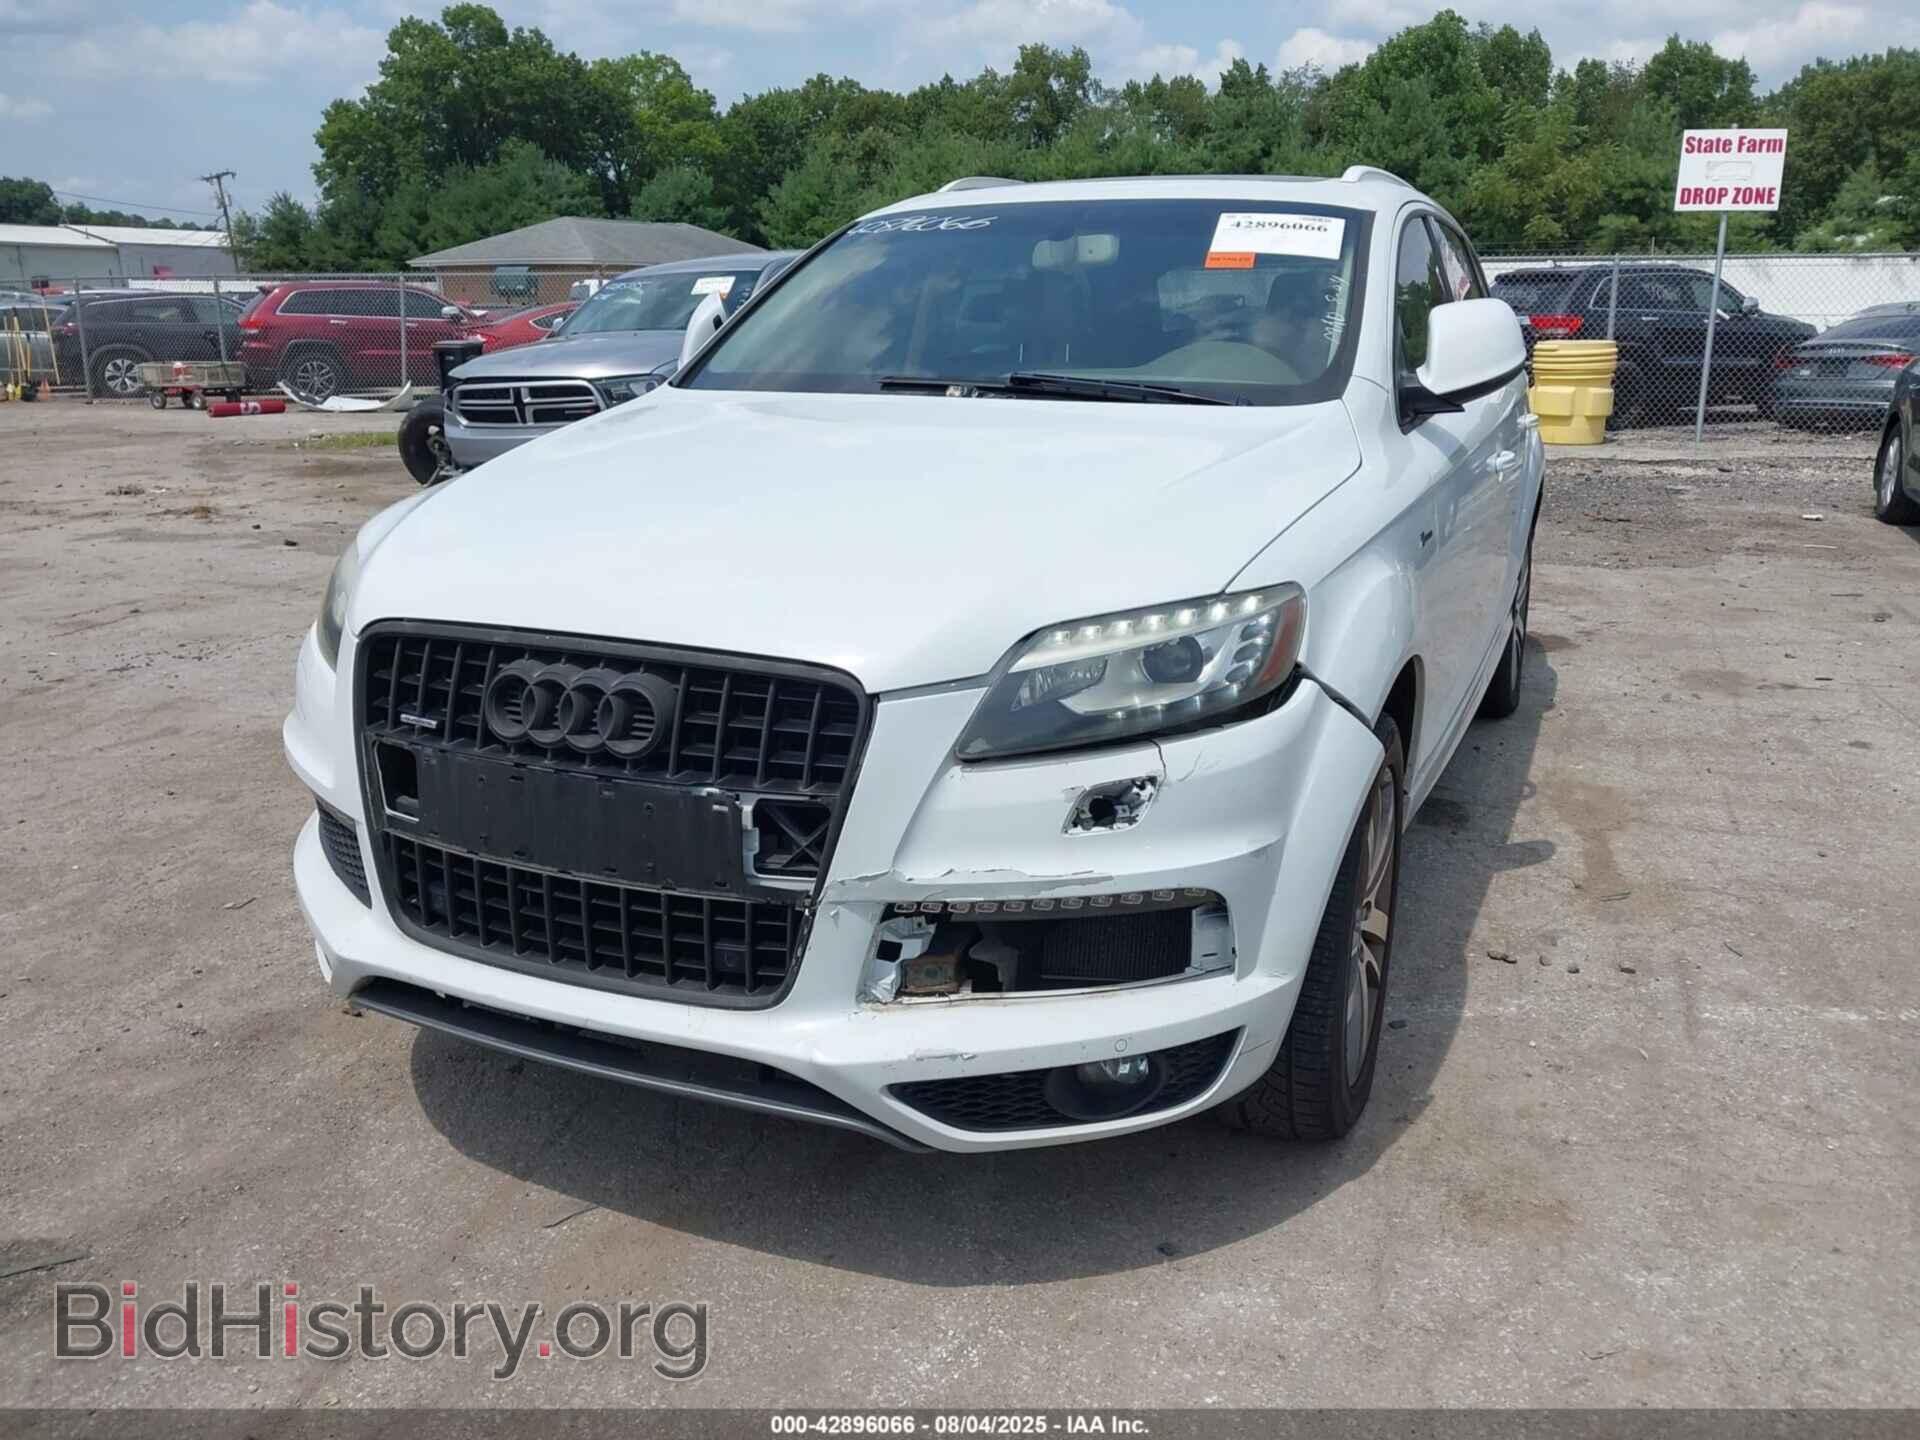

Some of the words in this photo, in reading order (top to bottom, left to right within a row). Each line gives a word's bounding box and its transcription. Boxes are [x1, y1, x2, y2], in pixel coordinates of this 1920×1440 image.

[1685, 136, 1732, 153] State
[1737, 136, 1783, 153] Farm
[1680, 187, 1728, 204] DROP
[1731, 187, 1776, 204] ZONE
[1231, 221, 1328, 233] 42896066
